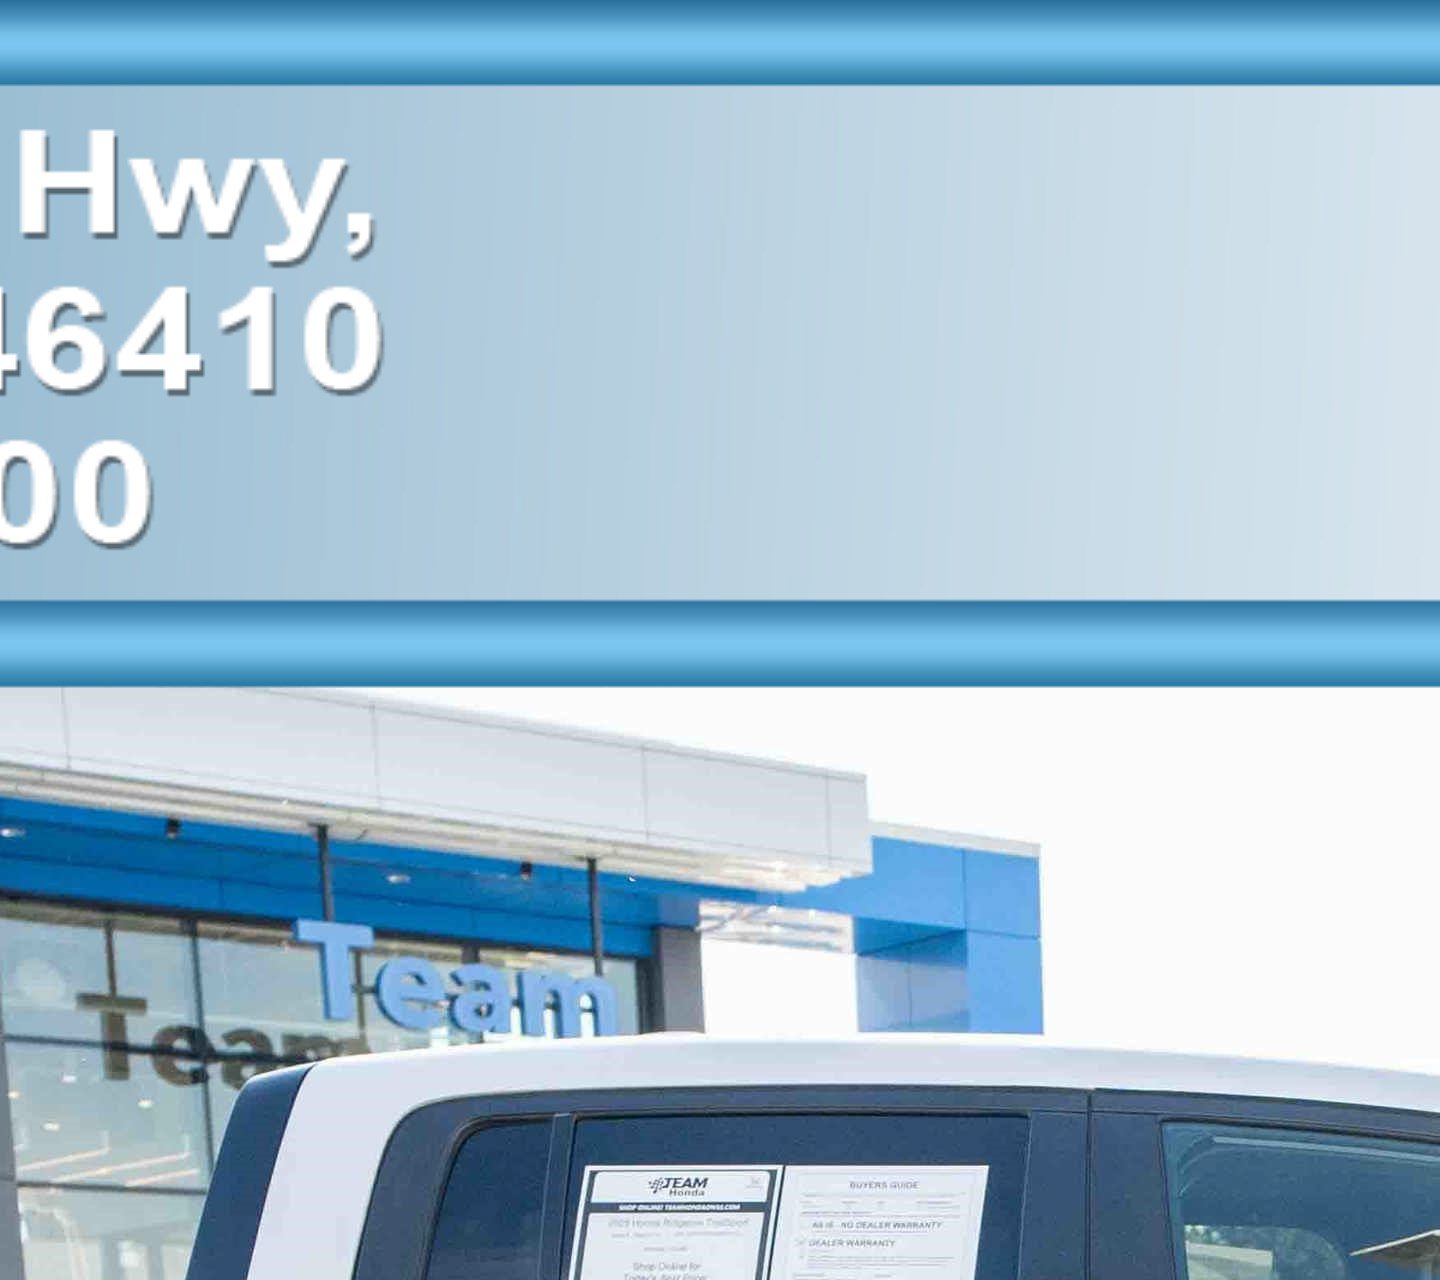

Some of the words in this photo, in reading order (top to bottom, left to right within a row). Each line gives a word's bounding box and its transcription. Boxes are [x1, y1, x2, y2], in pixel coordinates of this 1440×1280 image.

[293, 918, 617, 1038] Team
[662, 1176, 709, 1189] TEAM
[849, 1181, 887, 1190] BUYERS
[889, 1181, 920, 1190] GUIDE
[669, 1188, 706, 1197] Honda
[856, 1221, 891, 1230] DEALER
[892, 1221, 943, 1230] WARRANTY
[808, 1239, 844, 1248] DEALER
[846, 1239, 896, 1248] WARRANTY
